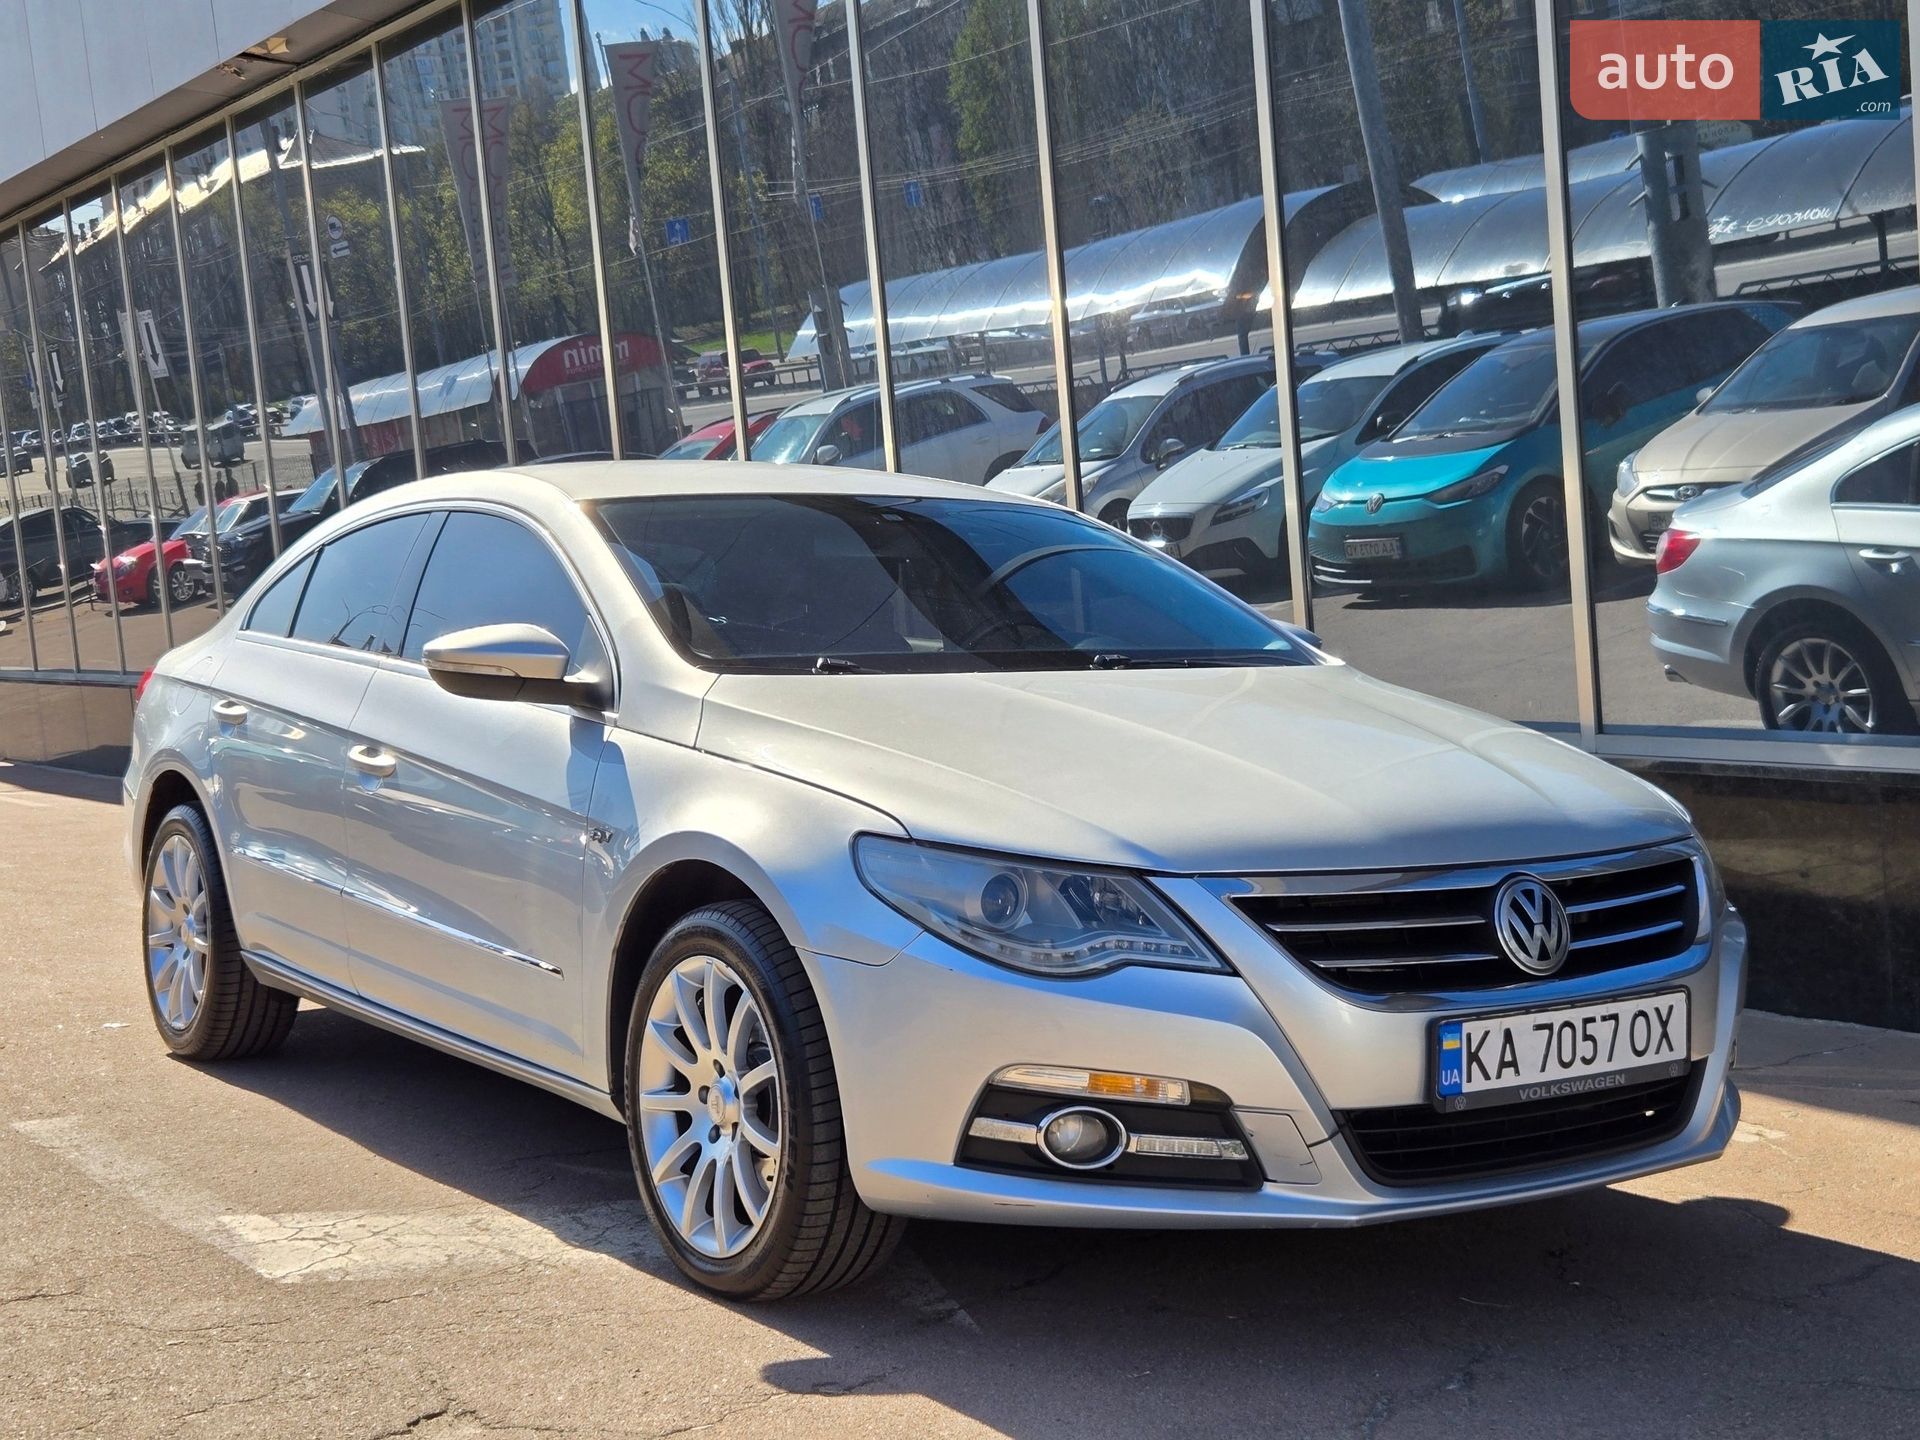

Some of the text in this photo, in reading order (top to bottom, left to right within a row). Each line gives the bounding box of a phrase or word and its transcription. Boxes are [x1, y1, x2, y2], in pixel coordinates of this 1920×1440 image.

[1499, 880, 1567, 970] VW
[1465, 1004, 1674, 1084] KA 7057 OX
[1442, 1068, 1461, 1086] UA
[1519, 1073, 1625, 1100] VOLKSWAGEN
